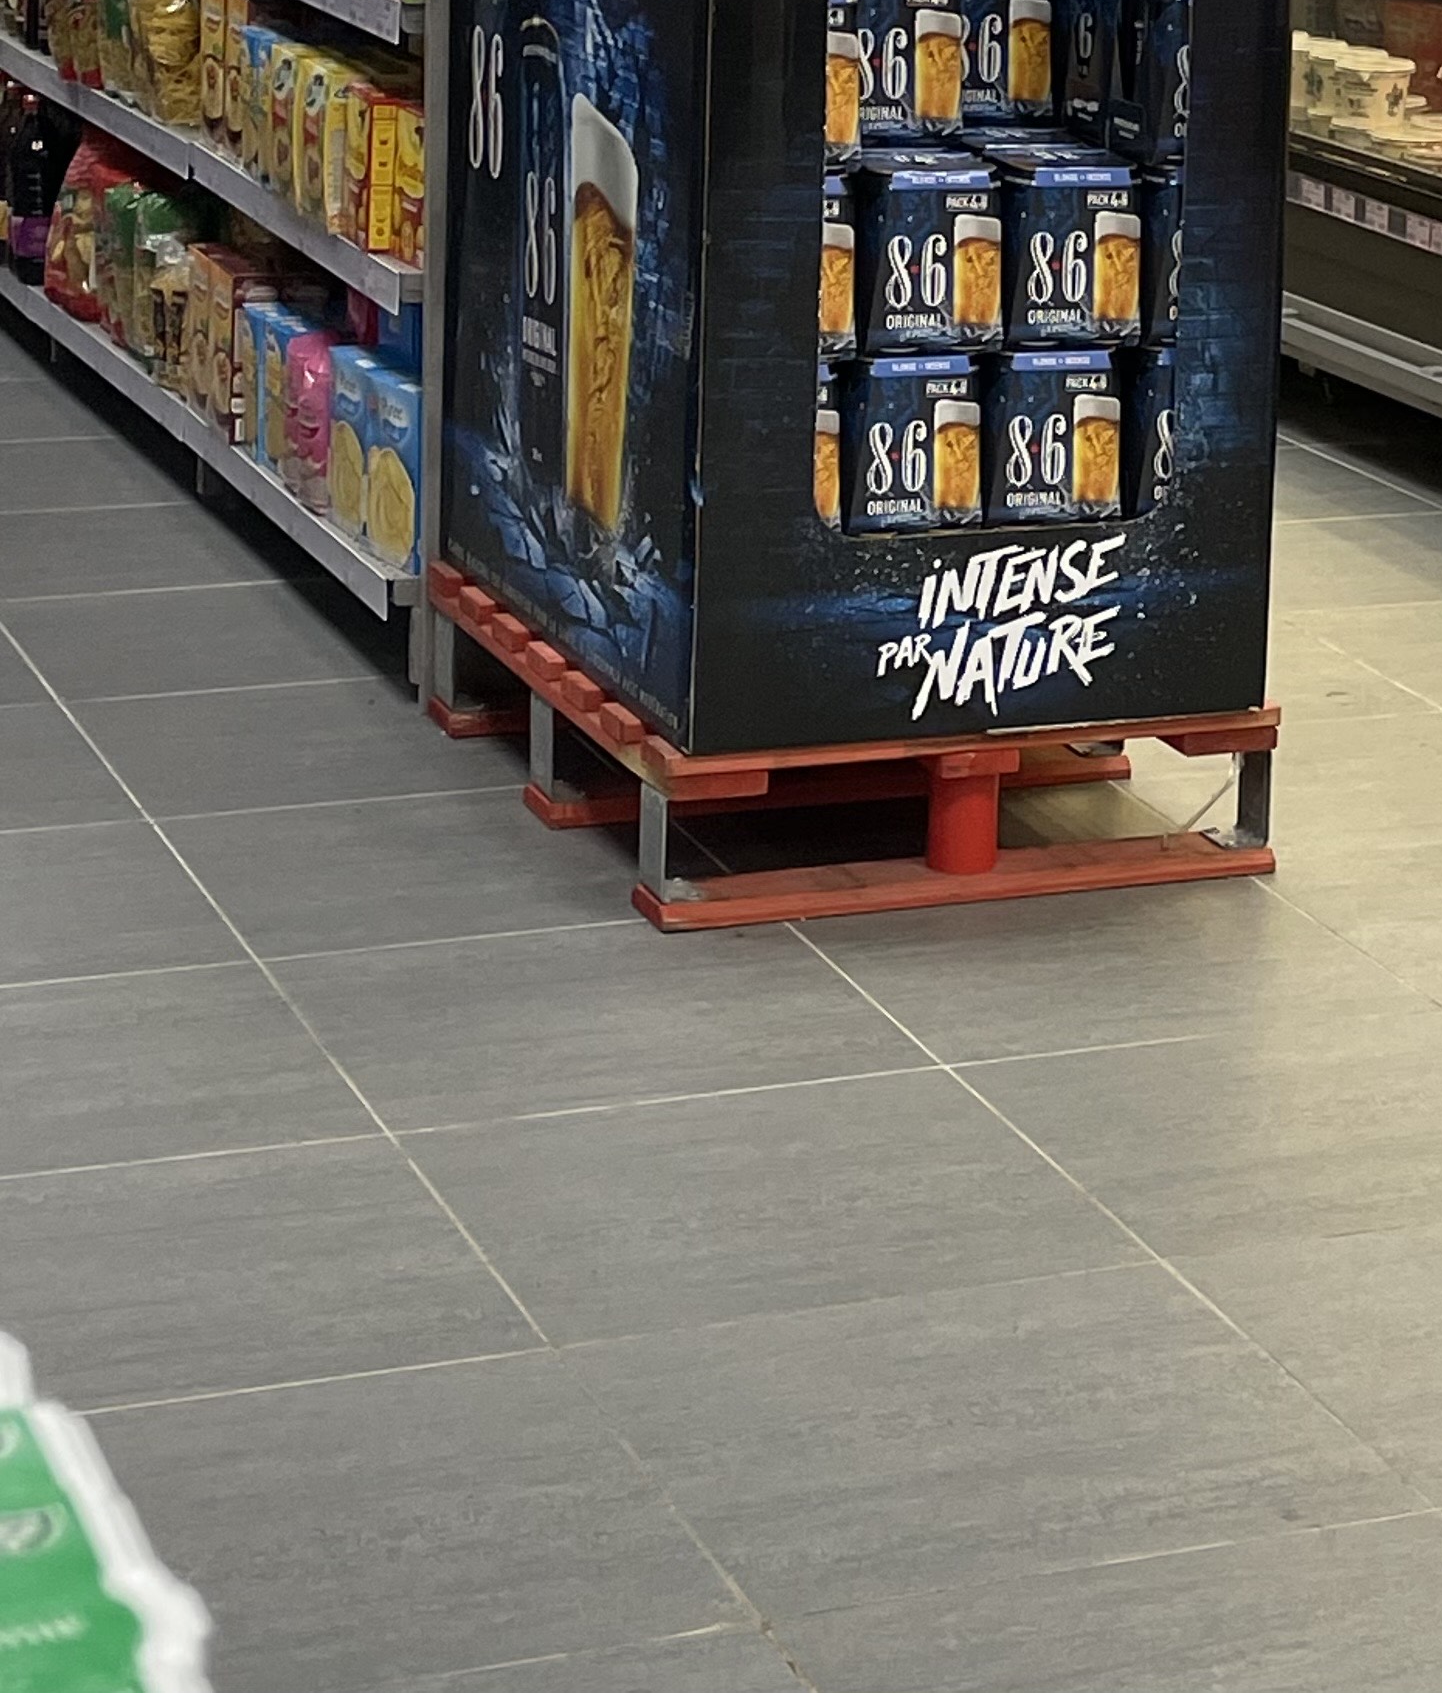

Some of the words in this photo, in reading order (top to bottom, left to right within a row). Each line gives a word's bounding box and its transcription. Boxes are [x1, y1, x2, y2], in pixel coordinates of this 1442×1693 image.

[859, 105, 904, 121] RIGINAL
[886, 312, 944, 331] ORIGINAL
[1027, 308, 1083, 325] ORIGINAL
[521, 314, 557, 356] ORIGINAL
[867, 499, 924, 517] ORIGINAL
[1006, 491, 1062, 508] ORIGINAL
[917, 533, 1127, 630] INTENSE
[876, 633, 933, 678] PAR
[911, 606, 1121, 722] NATURE
